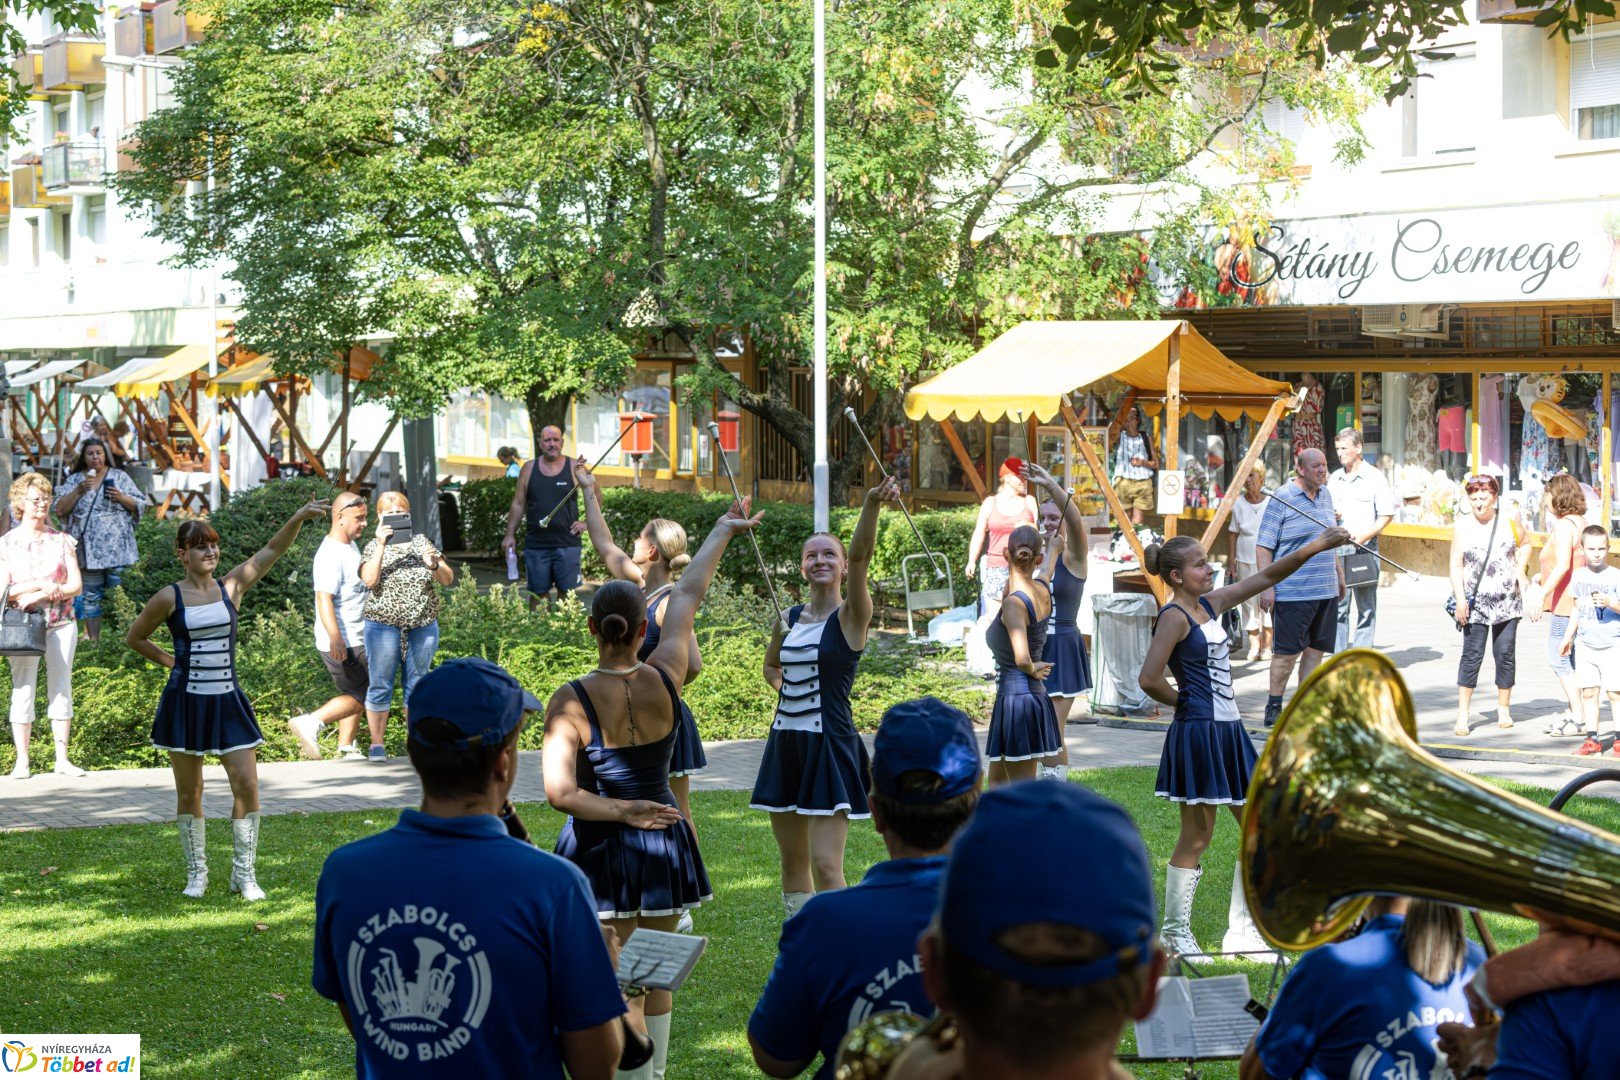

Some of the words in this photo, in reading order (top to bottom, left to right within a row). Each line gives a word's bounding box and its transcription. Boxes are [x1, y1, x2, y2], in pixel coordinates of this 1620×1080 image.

[1230, 225, 1378, 299] Sétány
[1391, 218, 1581, 294] Csemege
[358, 904, 477, 952] SZABOLCS
[865, 954, 925, 999] SZAB
[363, 1013, 409, 1061] WIND
[416, 1026, 471, 1062] BAND
[389, 1021, 438, 1034] HUNGARY
[1376, 1006, 1475, 1048] SZABO
